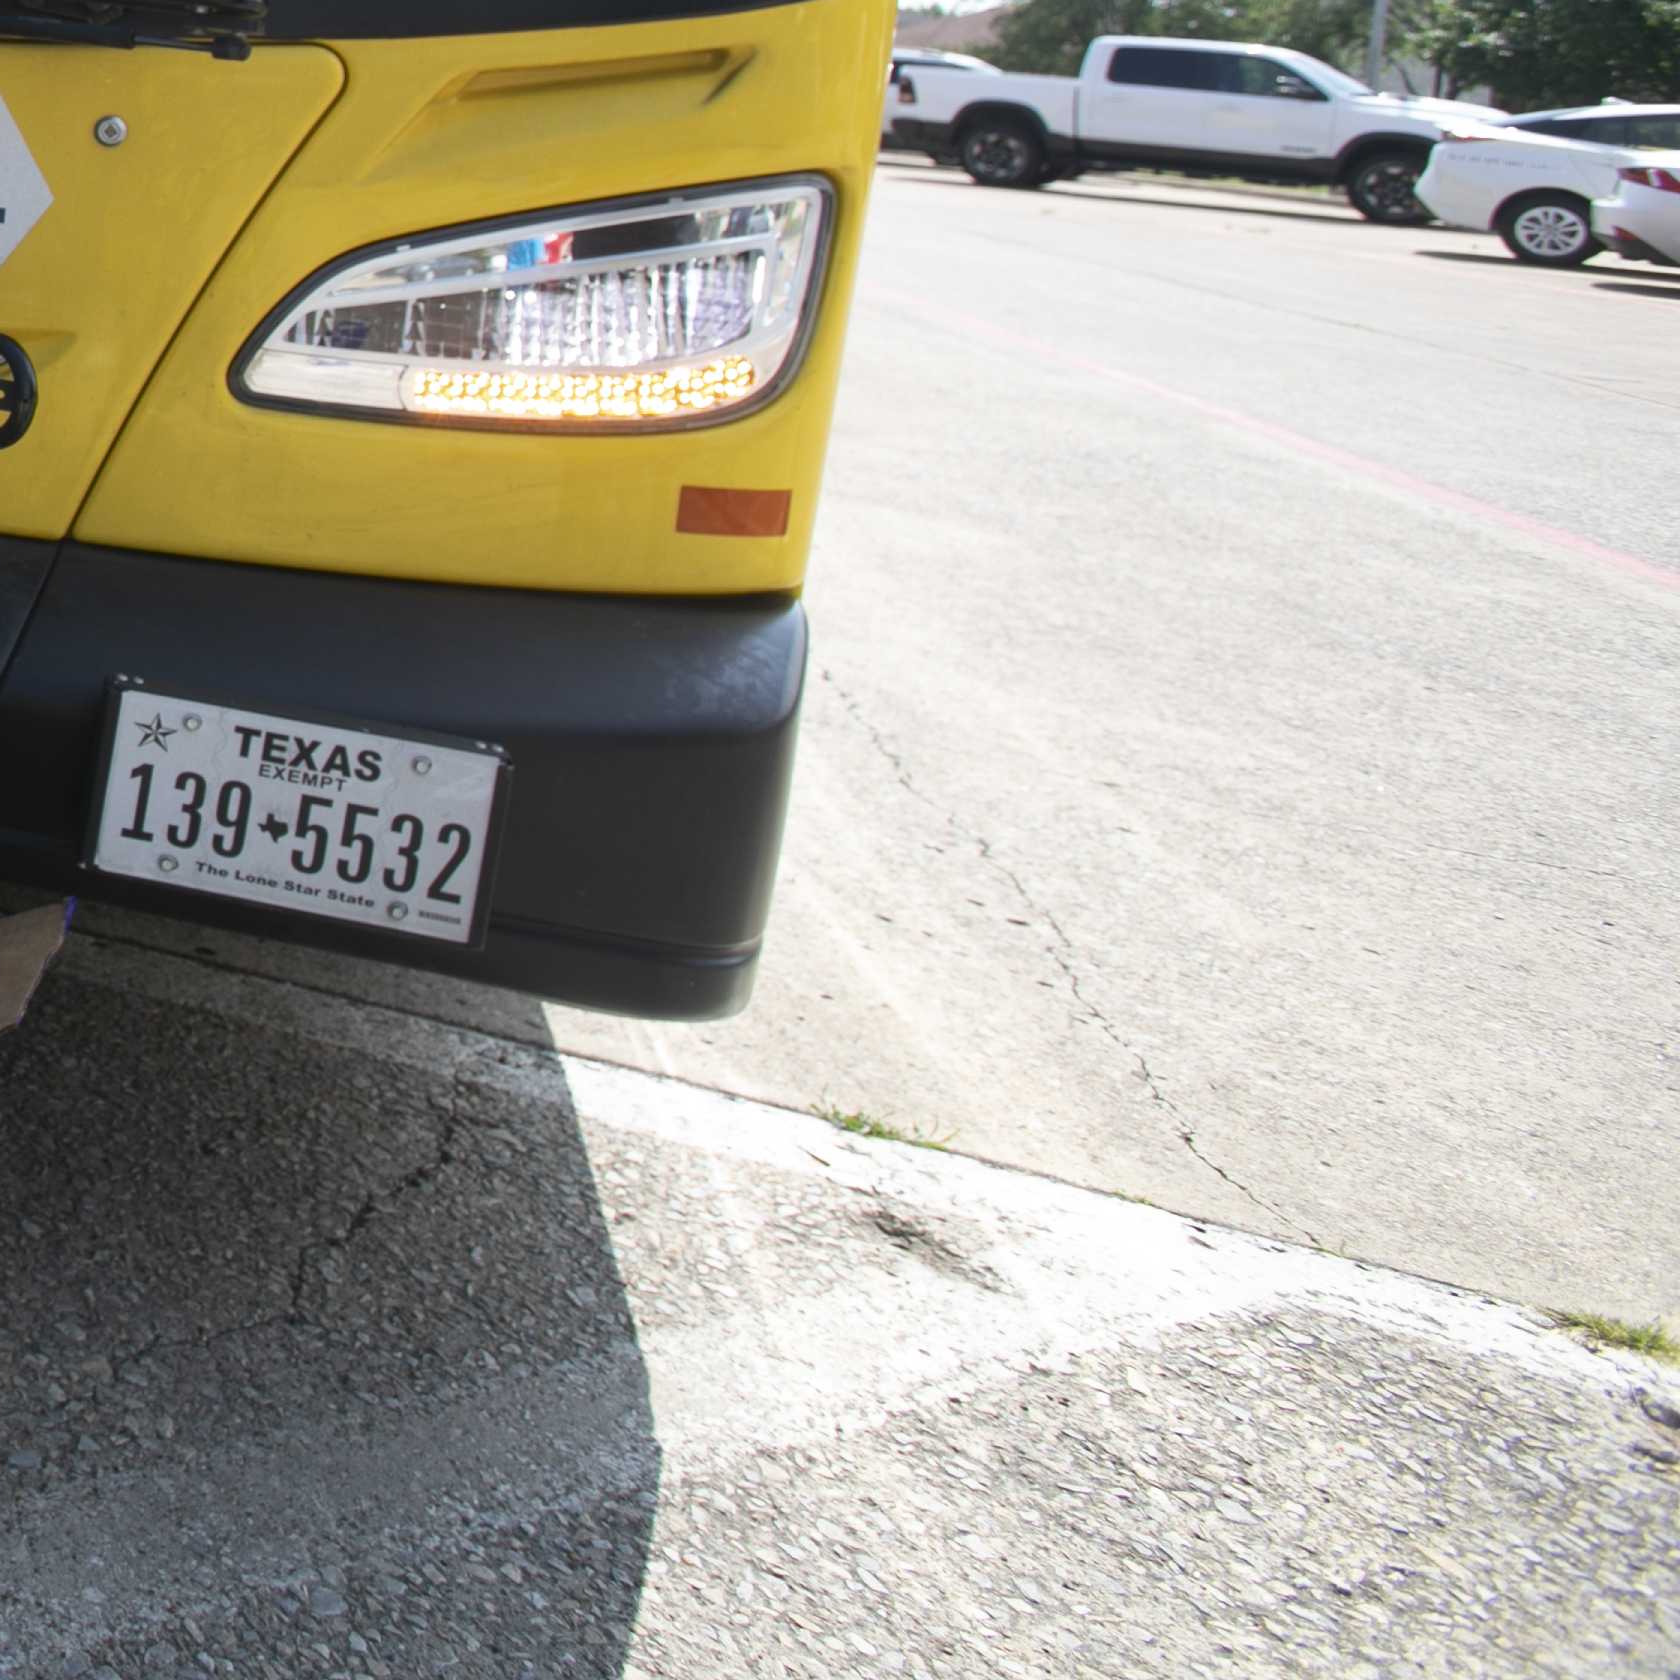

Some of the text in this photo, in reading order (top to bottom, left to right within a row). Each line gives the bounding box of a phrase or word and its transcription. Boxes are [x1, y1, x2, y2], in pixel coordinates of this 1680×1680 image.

[234, 726, 383, 783] TEXAS
[258, 763, 348, 793] EXEMPT
[121, 762, 472, 905] 139 5532
[195, 861, 375, 909] The Lone Star State
